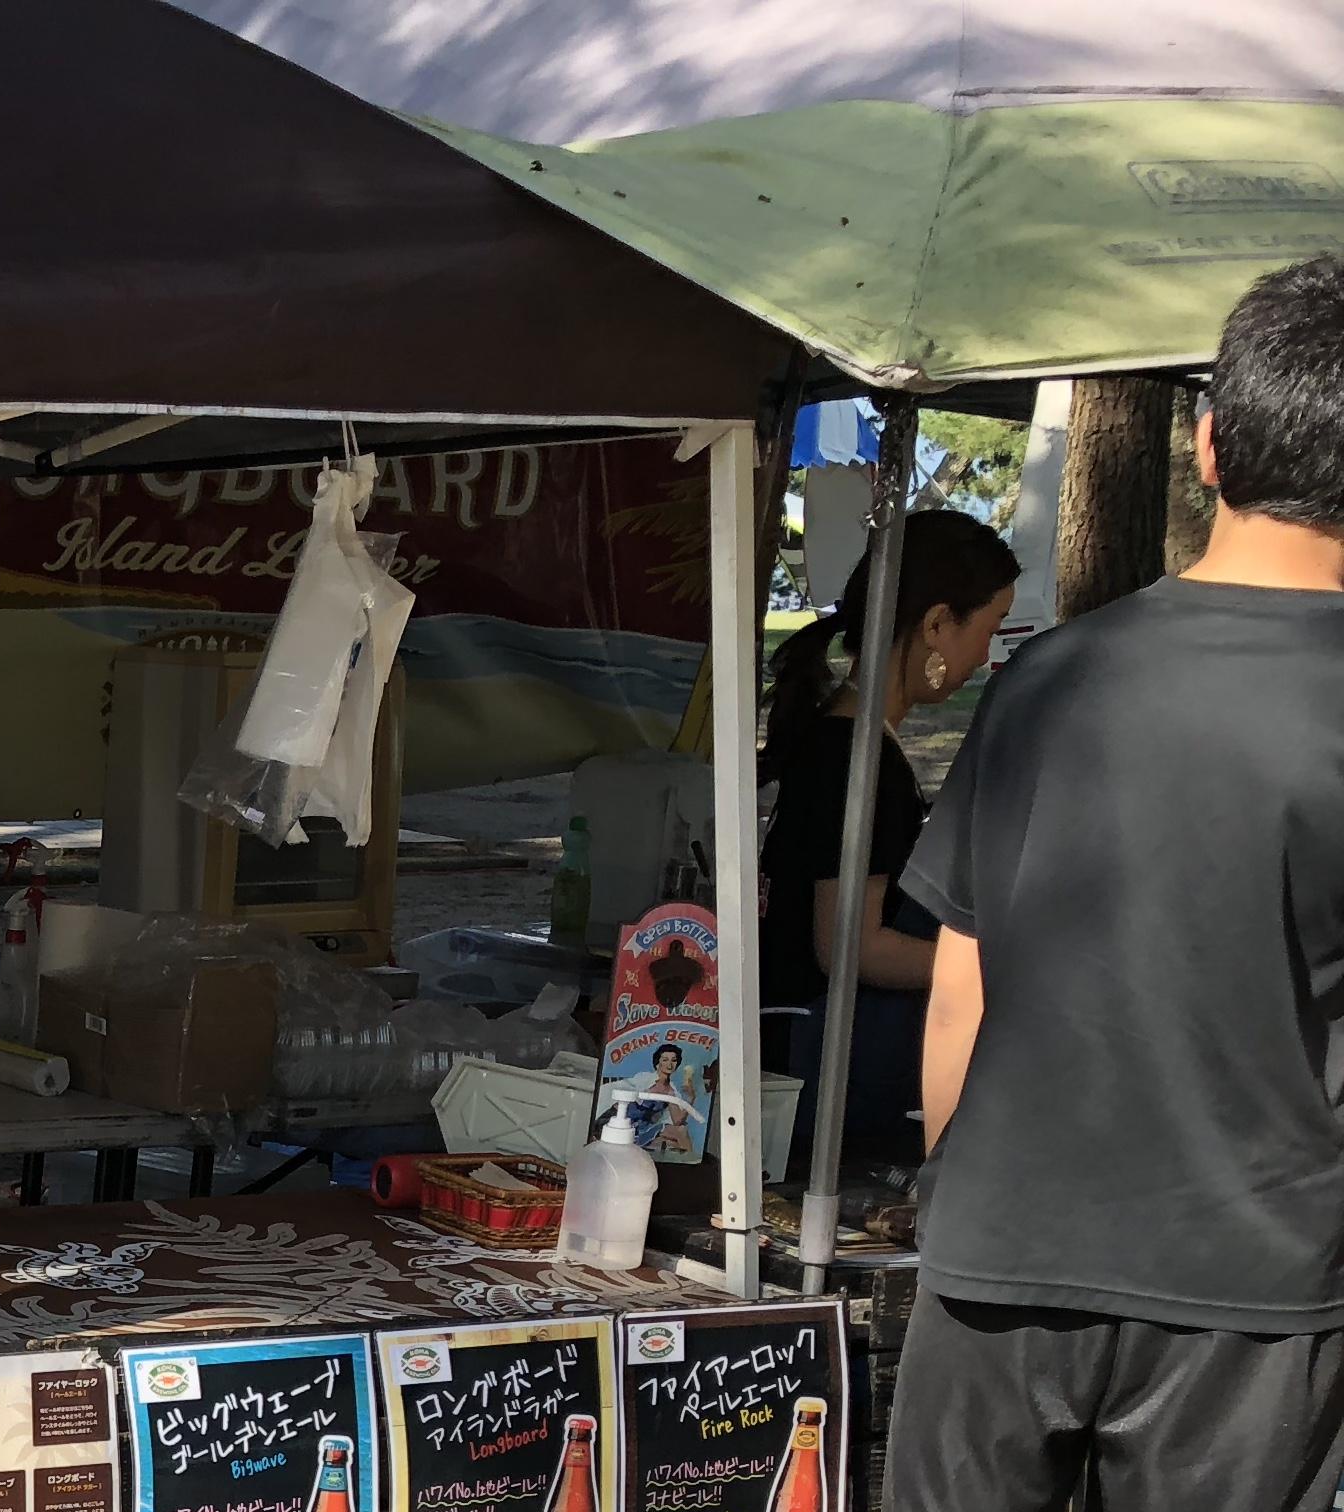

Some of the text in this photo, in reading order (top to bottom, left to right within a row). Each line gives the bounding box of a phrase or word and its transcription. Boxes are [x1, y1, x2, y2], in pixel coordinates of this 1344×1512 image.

[42, 514, 441, 584] Island Ler
[642, 920, 714, 952] OPEN BOTTLE
[613, 993, 660, 1032] Save
[610, 1029, 717, 1064] DRINK BEER!
[416, 1344, 580, 1424] ロングボード
[638, 1328, 817, 1406] ファイアーロック
[157, 1358, 340, 1446] ビッグウェーブ
[426, 1388, 580, 1451] アイランドラガー
[679, 1375, 803, 1423] ペールエール
[700, 1404, 775, 1440] Fire Rock
[172, 1409, 337, 1475] ゴールデンエール
[469, 1418, 549, 1462] Longboard
[230, 1451, 288, 1479] Bigwave
